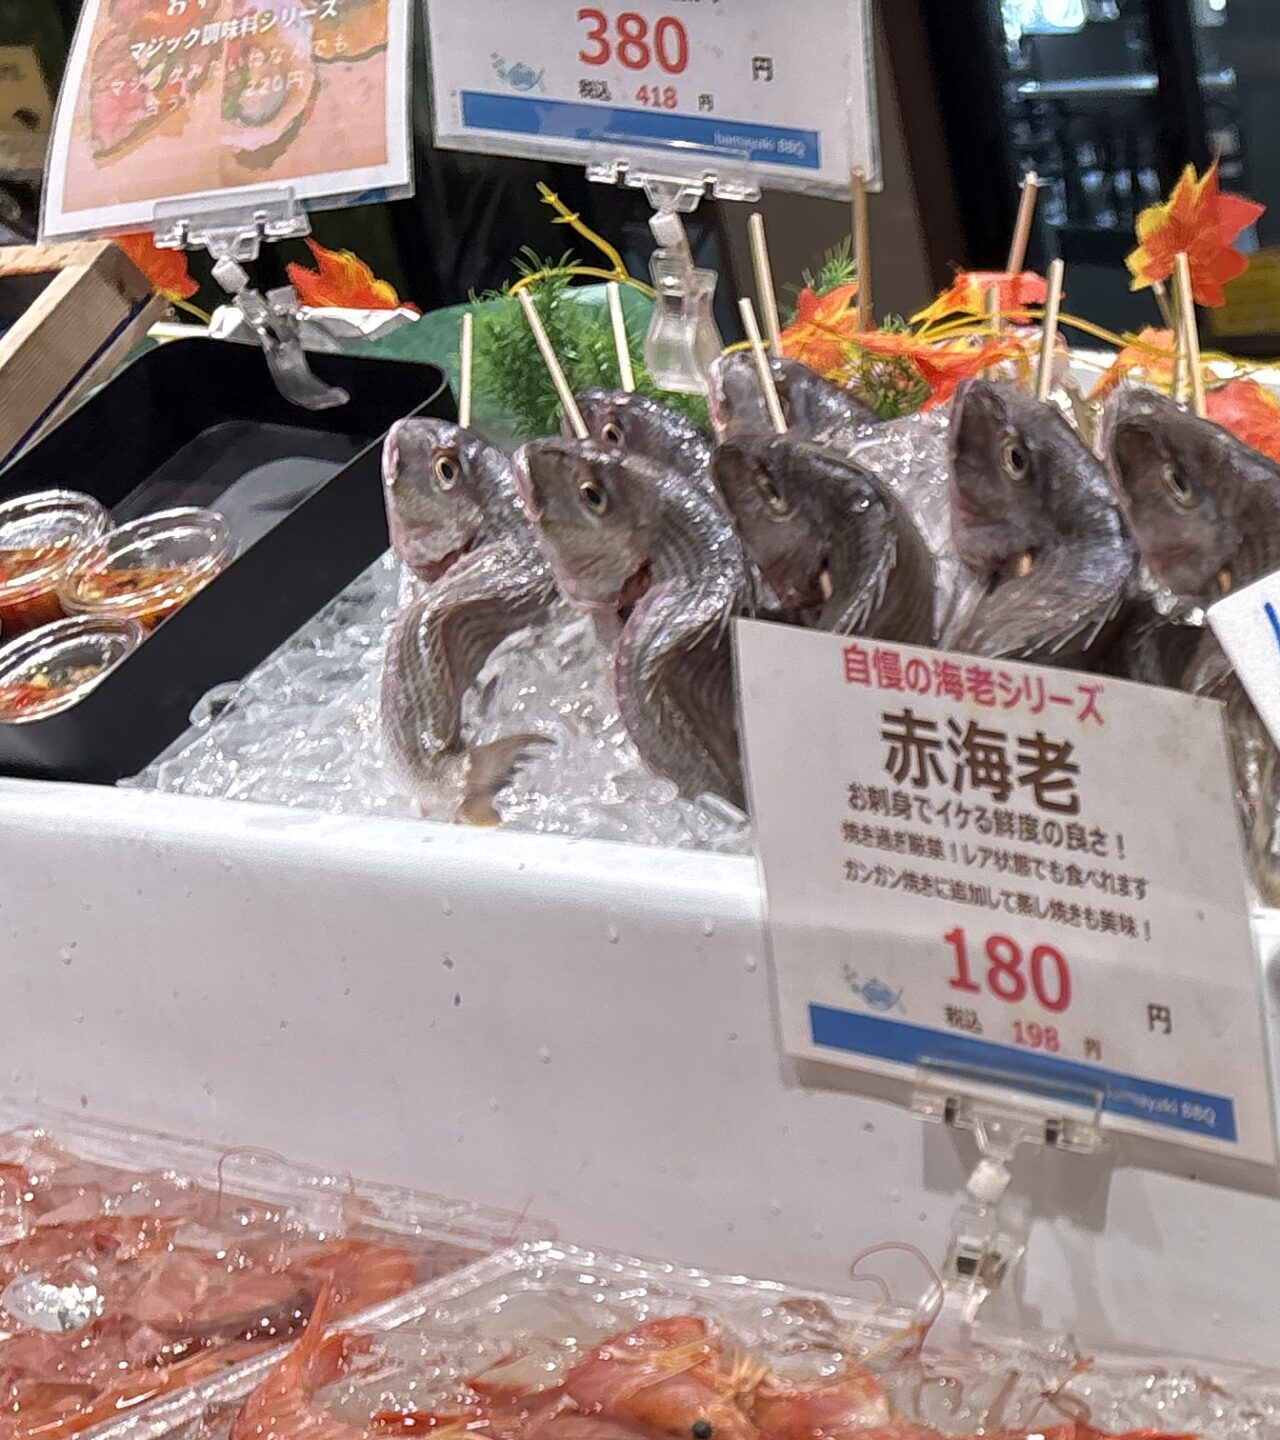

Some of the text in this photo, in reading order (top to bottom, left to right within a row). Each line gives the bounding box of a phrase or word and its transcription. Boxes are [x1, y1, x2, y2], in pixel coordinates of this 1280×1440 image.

[130, 0, 337, 61] マジック調味料シリーズ
[577, 8, 774, 82] 380 円
[578, 78, 714, 111] 税込 418 円
[843, 644, 1104, 725] 自慢の海老シリーズ
[881, 707, 1080, 815] 赤海老
[847, 782, 1125, 860] お刺身でイケる鮮度の良さ！
[943, 926, 1172, 1035] 180 円
[945, 1004, 983, 1034] 税込
[1011, 1020, 1060, 1052] 198
